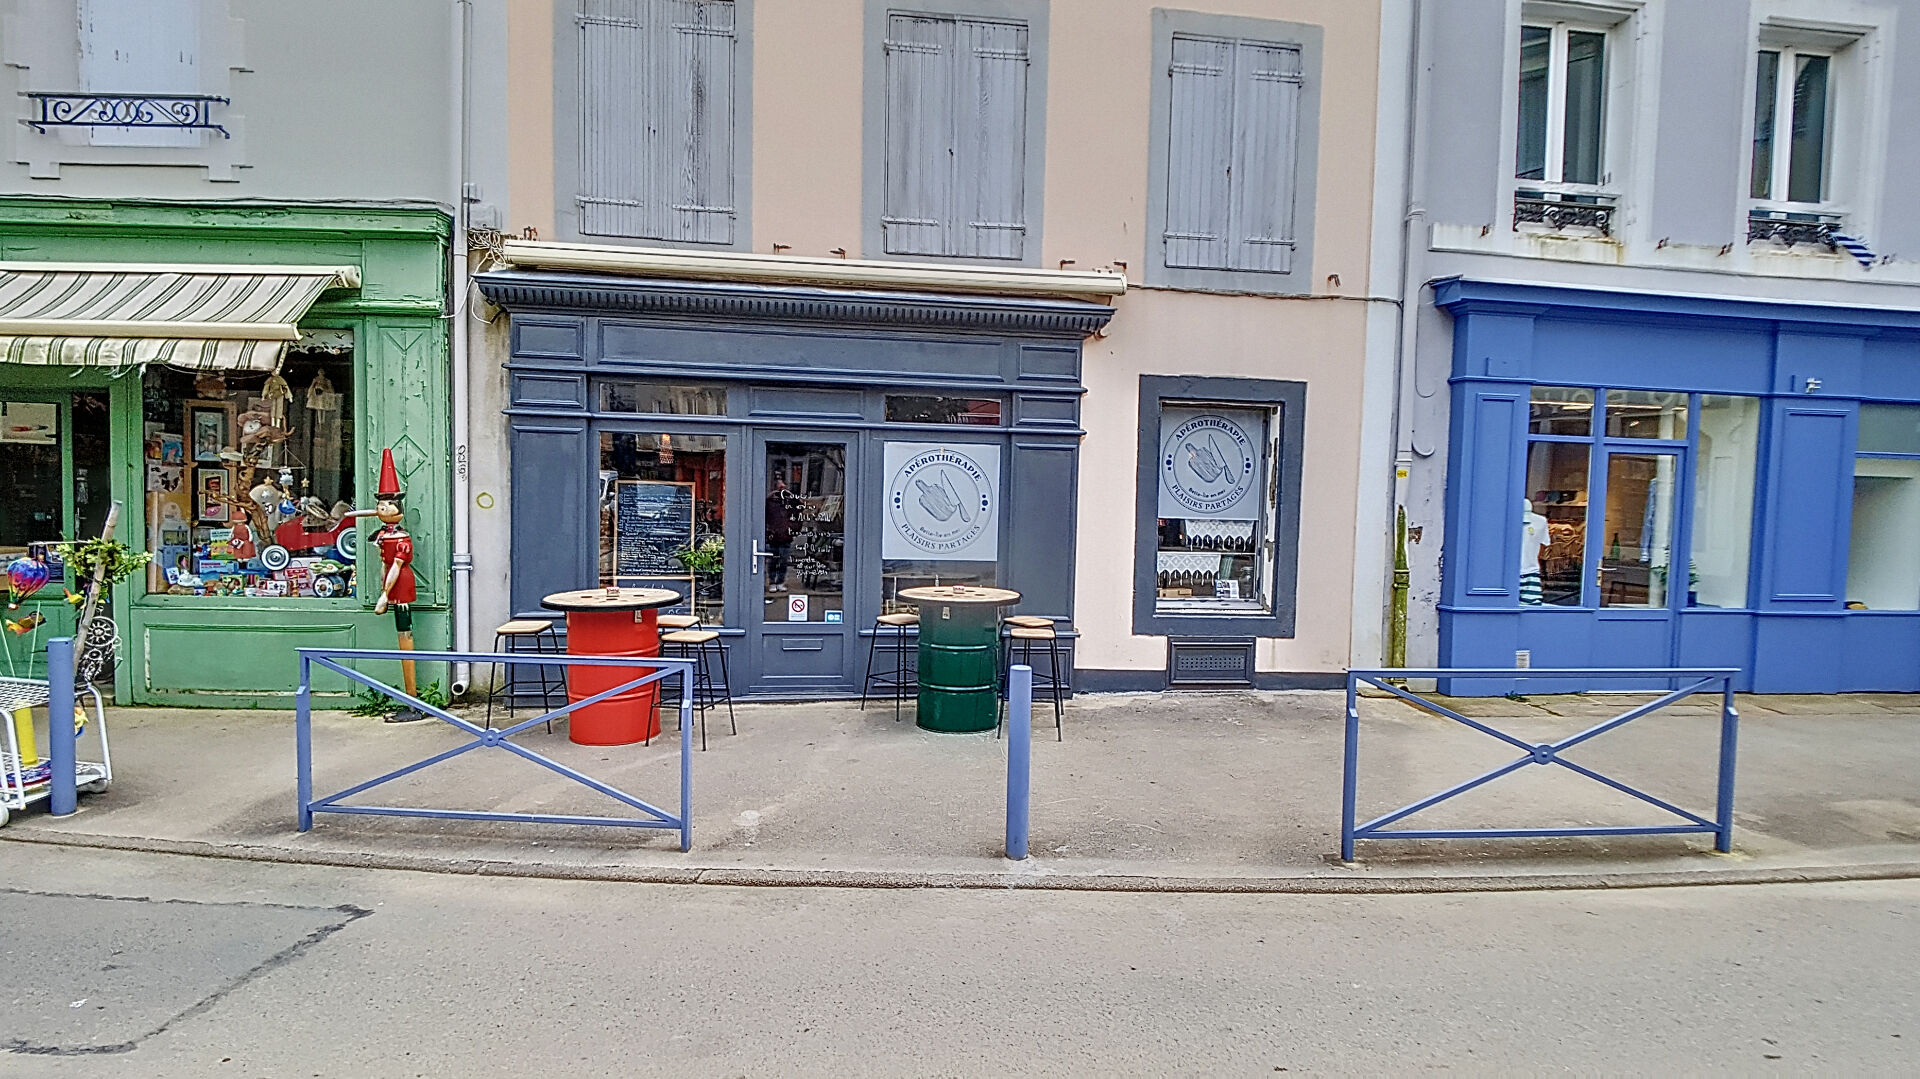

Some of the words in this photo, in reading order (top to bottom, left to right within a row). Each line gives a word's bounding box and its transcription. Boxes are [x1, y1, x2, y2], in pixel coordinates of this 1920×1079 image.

[1175, 419, 1246, 446] APÉROTHÉRAPIE
[904, 453, 982, 482] APÉROTHÉRAPIE
[1172, 484, 1203, 509] PLAISIRS
[901, 523, 936, 550] PLAISIRS
